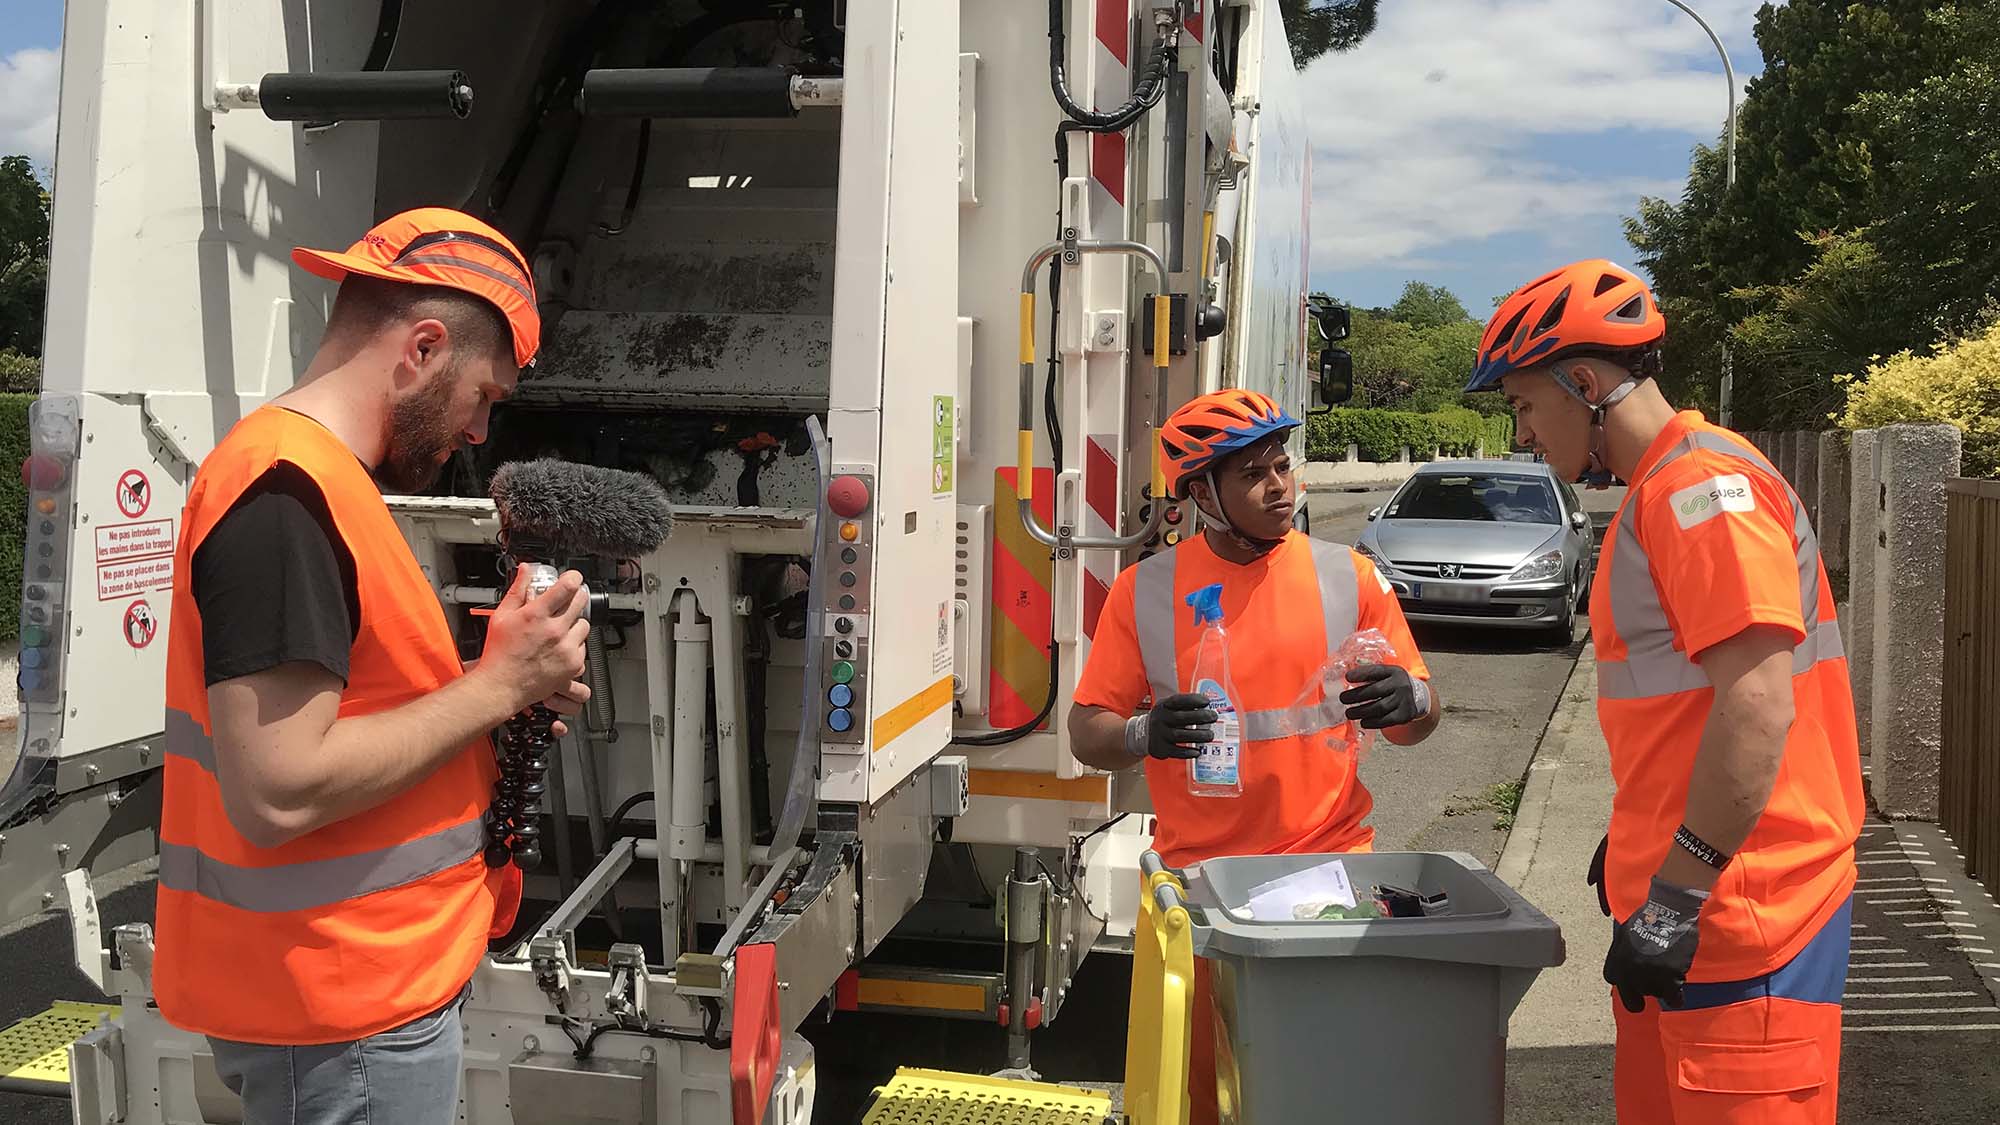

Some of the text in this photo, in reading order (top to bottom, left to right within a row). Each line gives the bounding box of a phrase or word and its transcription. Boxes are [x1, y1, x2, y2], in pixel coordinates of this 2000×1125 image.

[1709, 487, 1746, 502] suez
[109, 527, 161, 542] Ne pas introduire
[98, 538, 172, 556] les mains dans la trappe
[103, 563, 170, 580] Ne pas se placer dans
[101, 574, 173, 594] la zone de basculement
